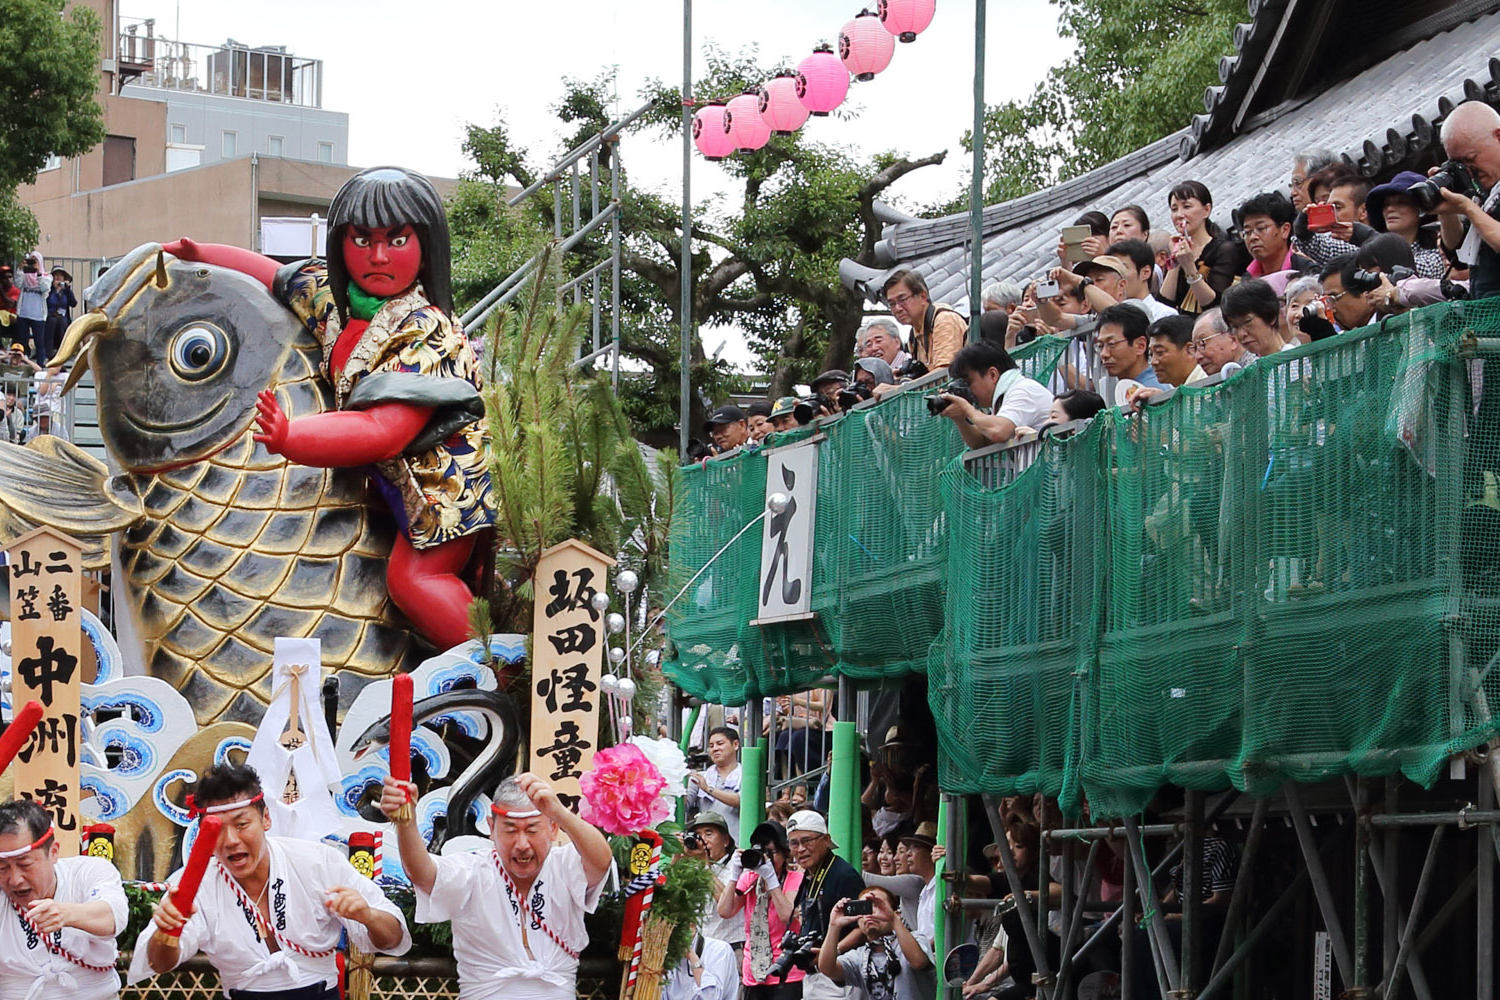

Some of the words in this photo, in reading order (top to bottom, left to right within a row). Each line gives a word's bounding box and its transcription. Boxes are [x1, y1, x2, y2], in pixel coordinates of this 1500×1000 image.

[762, 463, 801, 607] え
[12, 551, 41, 621] 山笠
[46, 551, 74, 622] 二番
